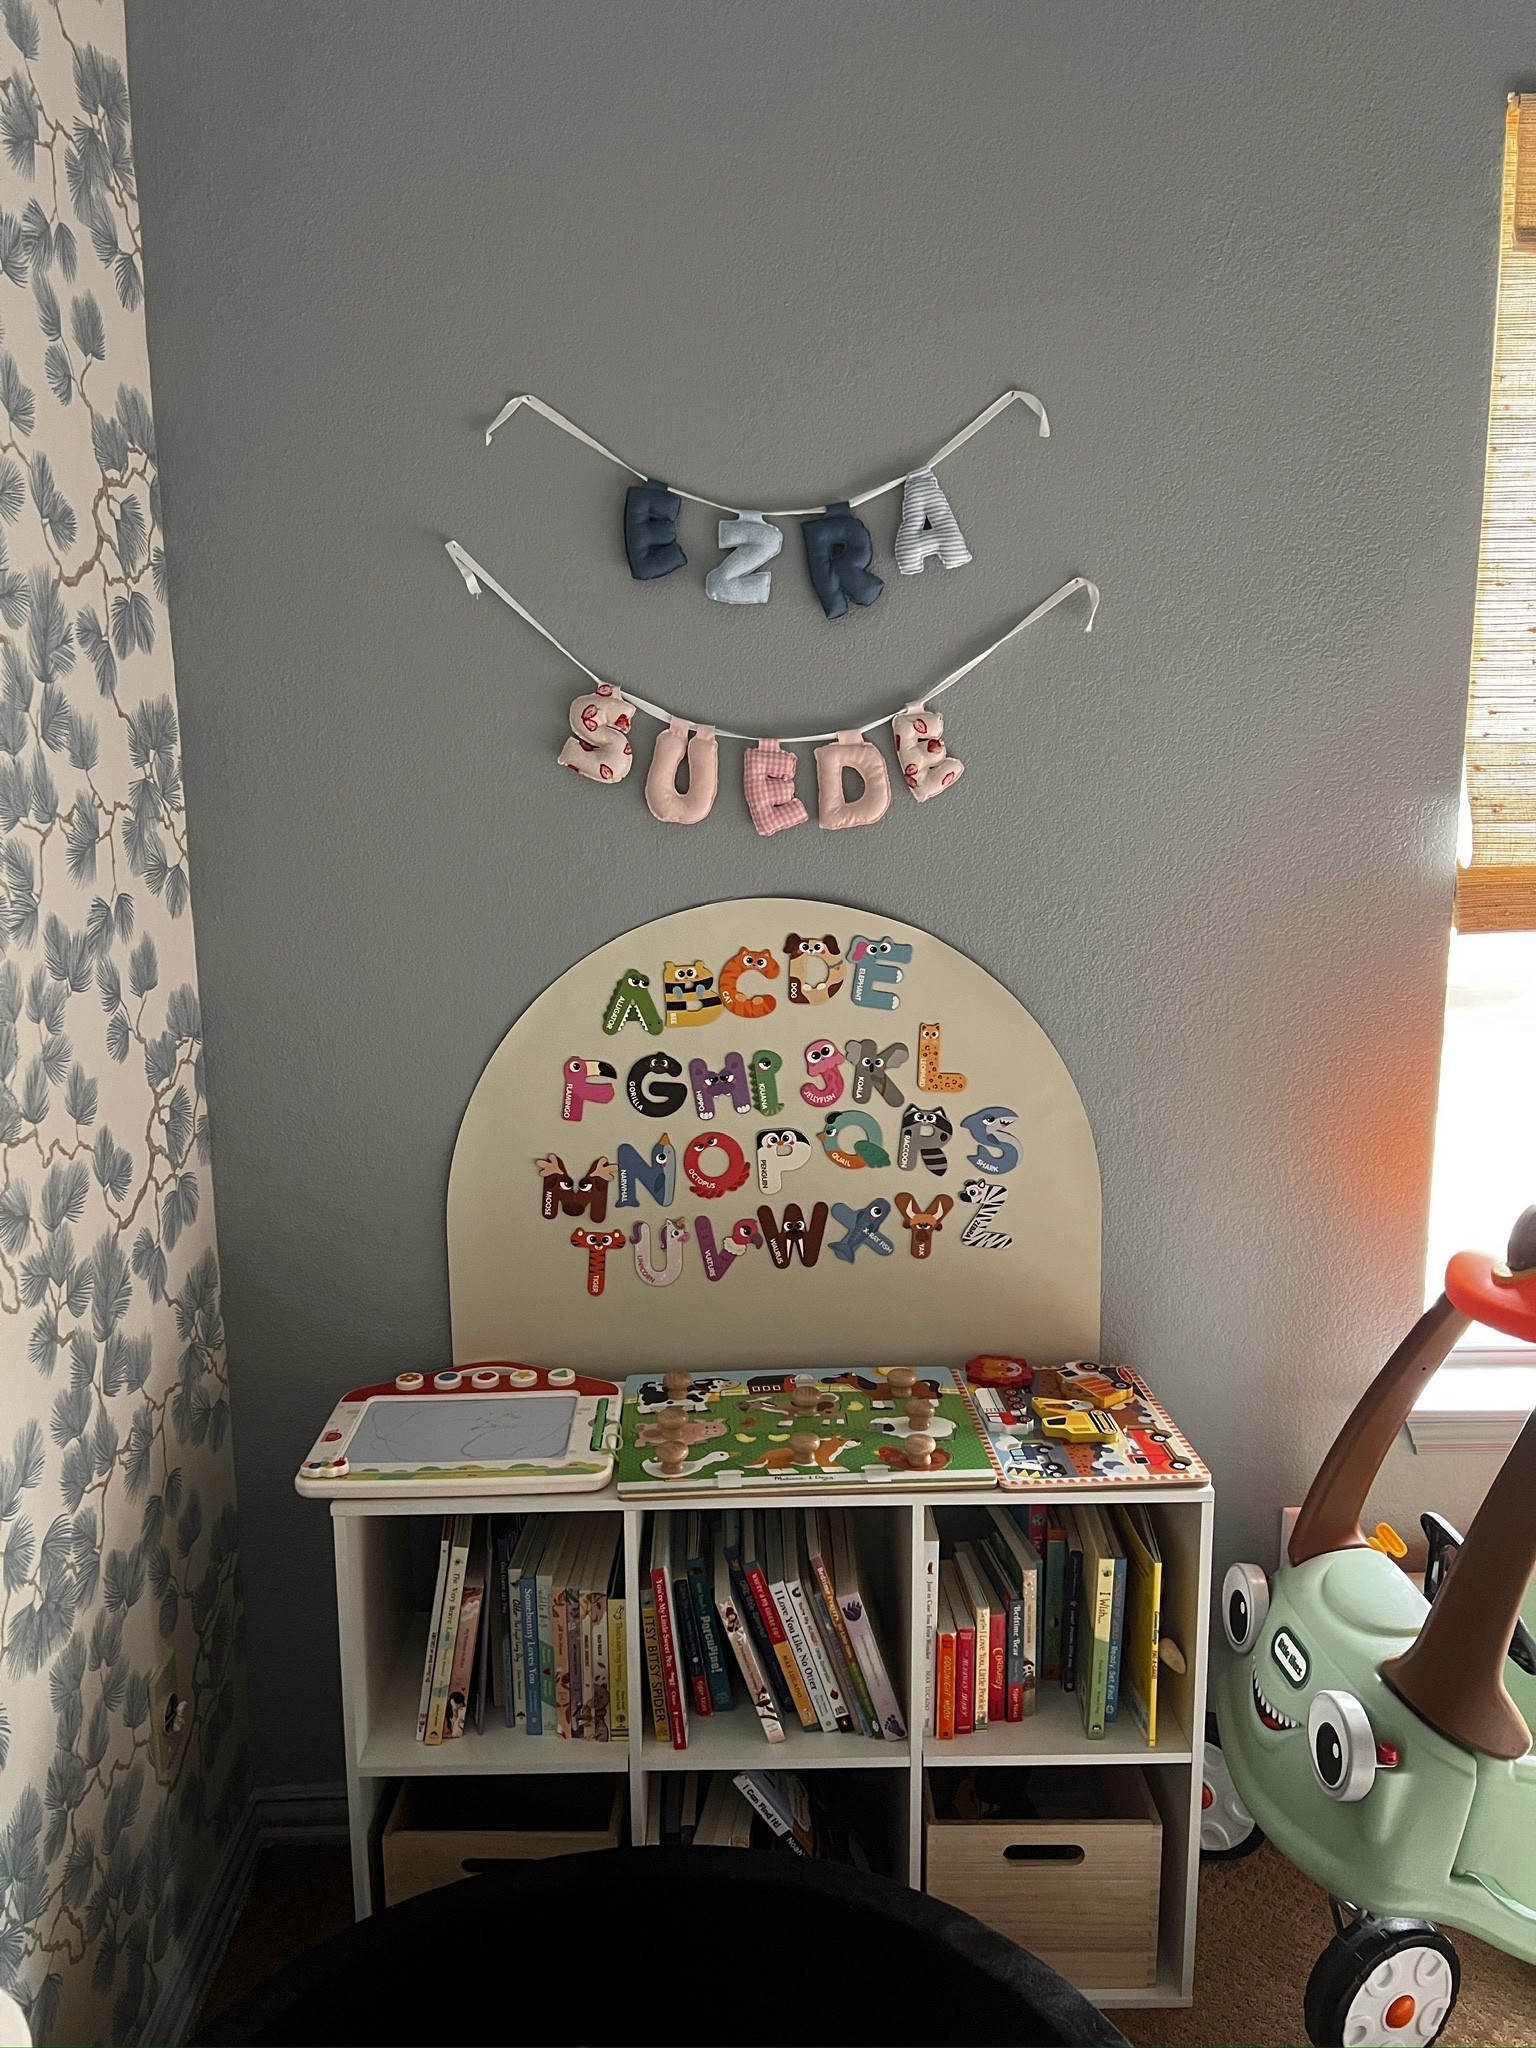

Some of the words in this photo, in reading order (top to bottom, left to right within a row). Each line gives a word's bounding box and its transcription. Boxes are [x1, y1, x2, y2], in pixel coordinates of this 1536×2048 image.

[622, 467, 973, 620] EZRA
[556, 683, 966, 836] SUEDE
[603, 968, 663, 1036] A
[664, 960, 722, 1028] B
[719, 946, 780, 1018] C
[783, 933, 846, 1005] D
[846, 935, 912, 1010] E
[855, 968, 866, 1001] ELEPHANT
[722, 990, 733, 1005] CAT
[607, 995, 626, 1030] ALLIGATOR
[669, 1013, 677, 1024] BEE
[562, 1056, 617, 1121] F
[627, 1051, 688, 1118] G
[689, 1052, 751, 1120] H
[749, 1050, 785, 1117] I
[800, 1039, 845, 1107] J
[845, 1039, 909, 1107] K
[916, 1023, 968, 1093] L
[628, 1080, 644, 1111] GORILLA
[758, 1083, 767, 1110] IGUANA
[804, 1090, 836, 1104] JELLYFISH
[856, 1077, 865, 1099] KOALA
[563, 1083, 573, 1119] FLAMINGO
[695, 1091, 706, 1111] HIPPO
[535, 1153, 618, 1223] M
[615, 1133, 676, 1208] N
[684, 1132, 751, 1199] O
[756, 1127, 812, 1194] P
[816, 1110, 891, 1169] Q
[898, 1104, 953, 1176] R
[961, 1106, 1023, 1175] S
[832, 1152, 850, 1168] QUAIL
[900, 1135, 911, 1169] RACCOON
[975, 1159, 999, 1173] SHARK
[688, 1168, 716, 1190] OCTOPUS
[570, 1227, 626, 1296] T
[629, 1217, 690, 1287] U
[695, 1215, 763, 1282] V
[757, 1201, 828, 1269] W
[828, 1197, 894, 1264] X
[895, 1192, 954, 1259] Y
[959, 1178, 1013, 1249] Z
[862, 1227, 881, 1243] X-RAY
[876, 1238, 893, 1254] FISH
[963, 1221, 979, 1238] ZEBRA
[704, 1249, 715, 1277] VULTURE
[770, 1238, 783, 1265] WALRUS
[637, 1255, 655, 1284] UNICORN
[452, 1573, 460, 1584] The
[655, 1579, 665, 1602] You're
[448, 1588, 459, 1602] Very
[817, 1567, 832, 1595] Bedtime
[827, 1595, 840, 1621] Prayers
[447, 1606, 455, 1624] Brave
[512, 1599, 521, 1618] Otto
[524, 1588, 535, 1639] Somebunny
[657, 1602, 667, 1614] My
[644, 1616, 655, 1641] ITSY
[660, 1615, 669, 1634] Little
[1012, 1605, 1021, 1637] Bedtime
[527, 1642, 536, 1666] Loves
[662, 1634, 671, 1654] Sweet
[777, 1596, 789, 1616] Love
[784, 1616, 796, 1634] You
[791, 1635, 803, 1653] Like
[799, 1655, 809, 1667] No
[804, 1668, 819, 1691] Otter
[1012, 1638, 1021, 1656] Bear
[648, 1646, 660, 1677] BITSY
[665, 1655, 673, 1667] Pea
[978, 1653, 987, 1667] You,
[1277, 1637, 1290, 1660] little
[1288, 1653, 1302, 1677] tikes
[528, 1668, 538, 1684] You
[944, 1655, 952, 1696] GOODNIGHT
[652, 1682, 665, 1723] SPIDER
[978, 1688, 986, 1710] Pookie
[1107, 1685, 1115, 1700] Find
[943, 1699, 951, 1720] MOON
[747, 1789, 759, 1804] Can
[758, 1802, 773, 1819] Find
[770, 1818, 782, 1828] It!
